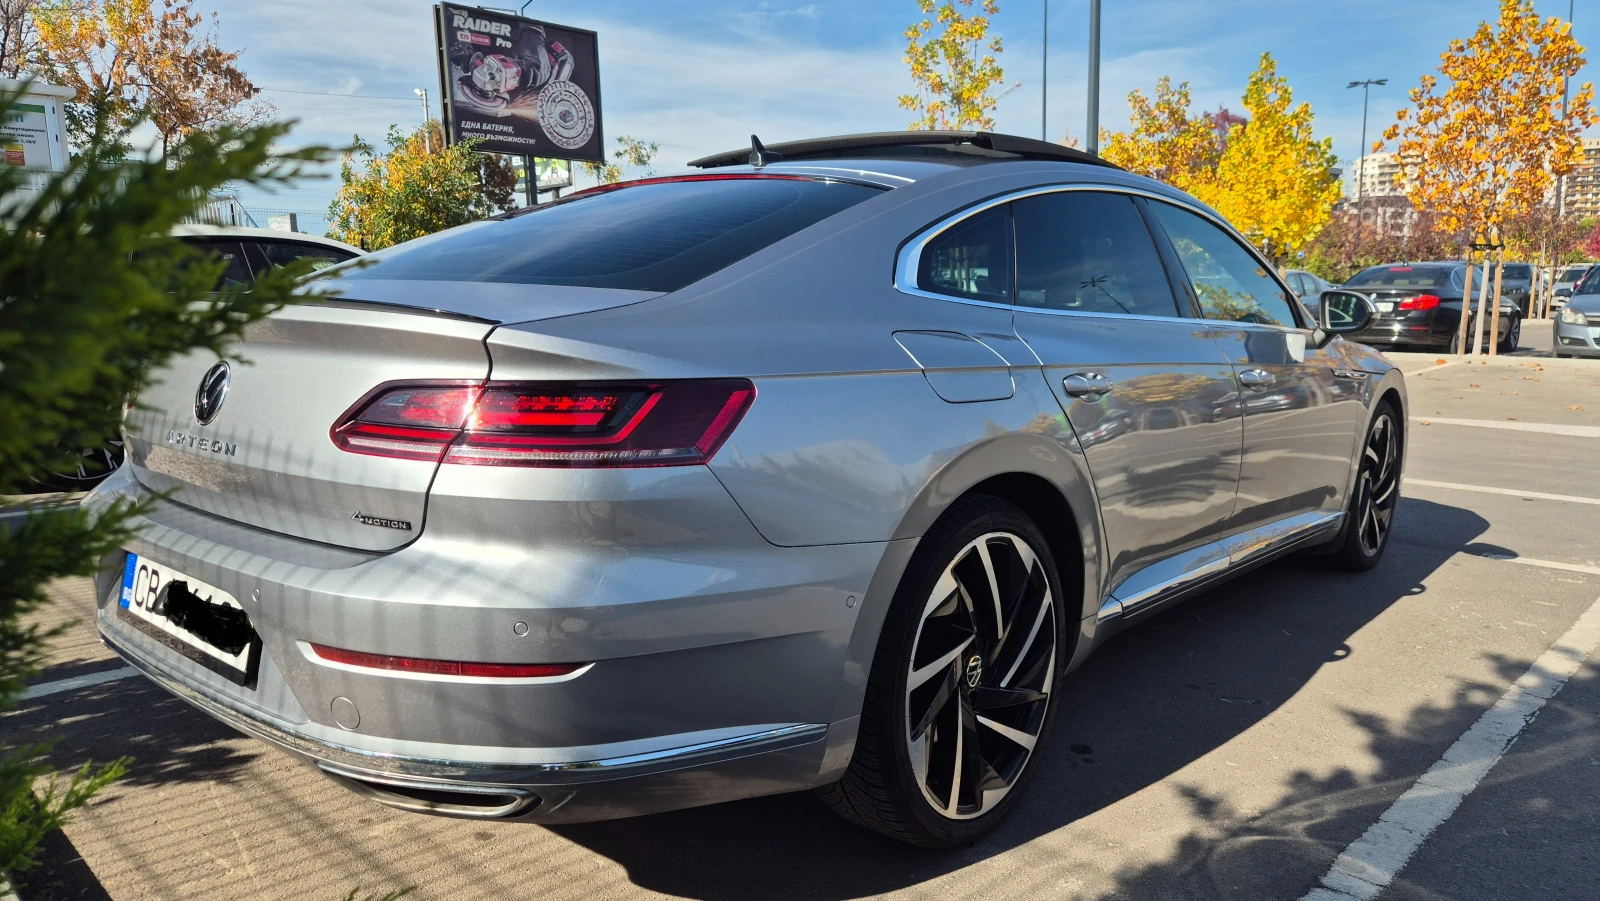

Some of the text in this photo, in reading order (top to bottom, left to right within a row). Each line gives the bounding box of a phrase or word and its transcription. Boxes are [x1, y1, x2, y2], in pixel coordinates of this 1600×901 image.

[453, 14, 511, 37] RAIDER
[496, 37, 512, 48] Pro
[461, 120, 515, 134] ЕДНА БАТЕРИЯ,
[461, 131, 536, 145] МНОГО ВЪЗМОЖНОСТИ!
[165, 430, 236, 457] ARTEON
[351, 510, 407, 530] 4MOTION
